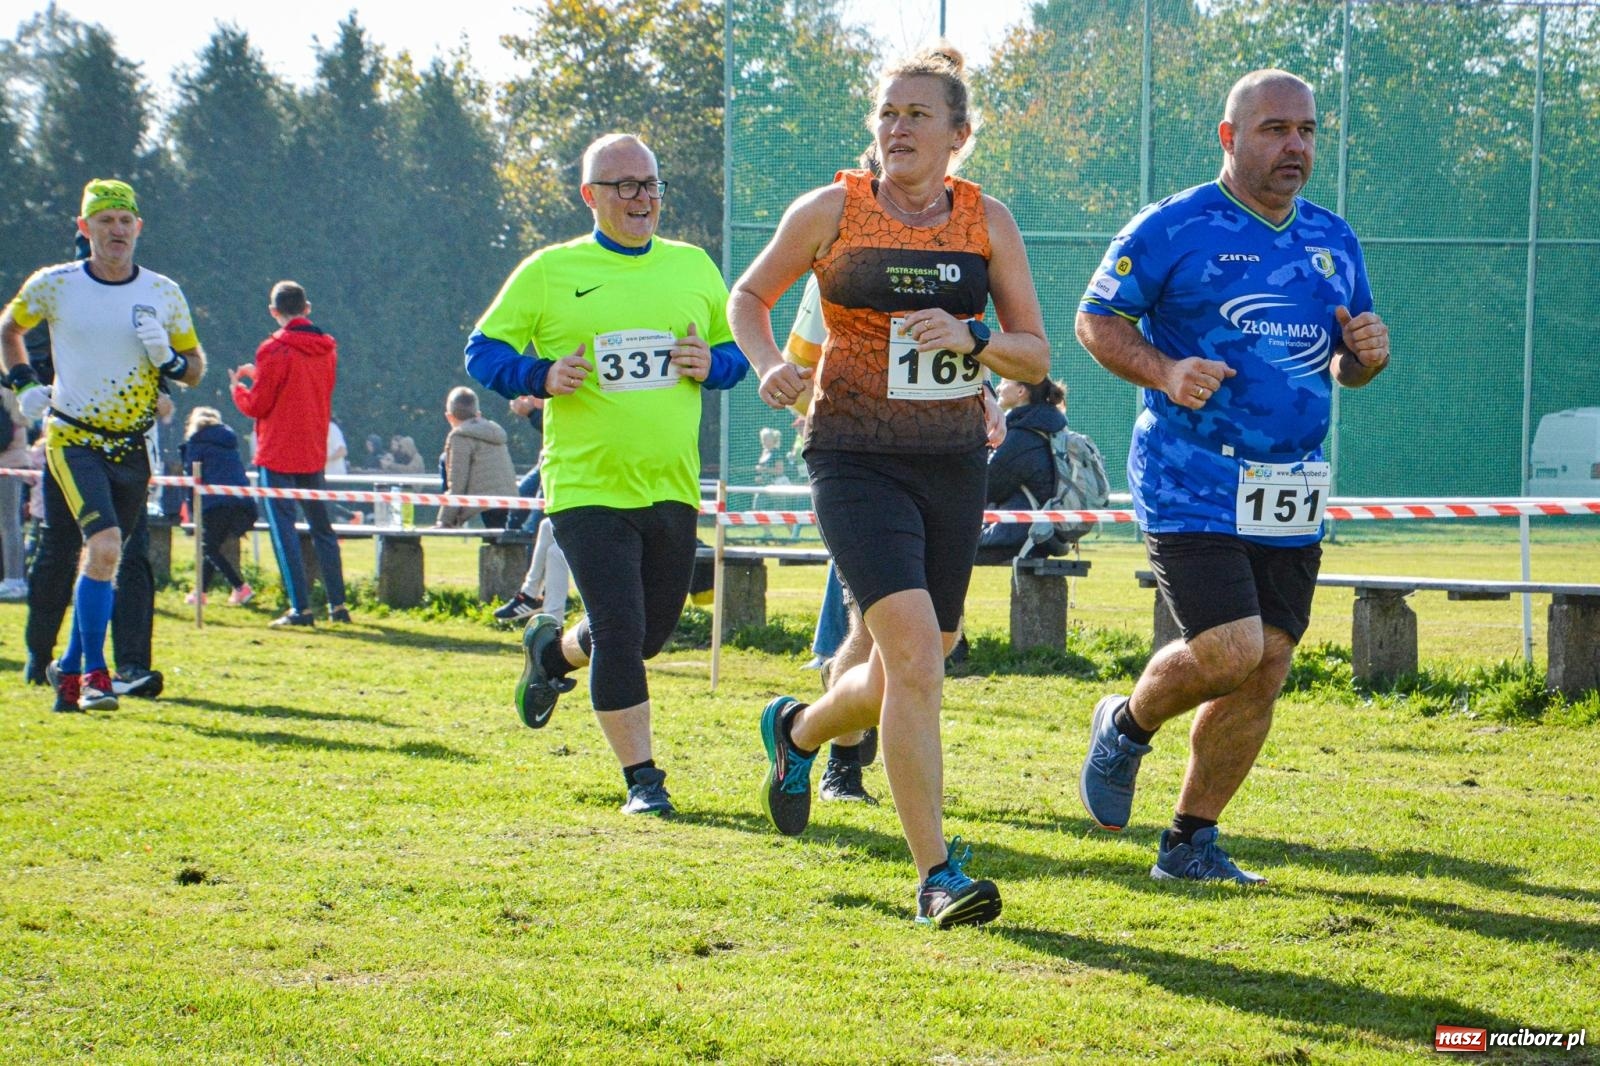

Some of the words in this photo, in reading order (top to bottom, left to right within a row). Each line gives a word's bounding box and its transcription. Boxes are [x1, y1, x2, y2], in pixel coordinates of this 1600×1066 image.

[936, 263, 961, 283] 10
[1241, 319, 1319, 339] ZŁOM-MAX
[600, 349, 674, 382] 337
[898, 347, 980, 385] 169
[1245, 487, 1320, 523] 151
